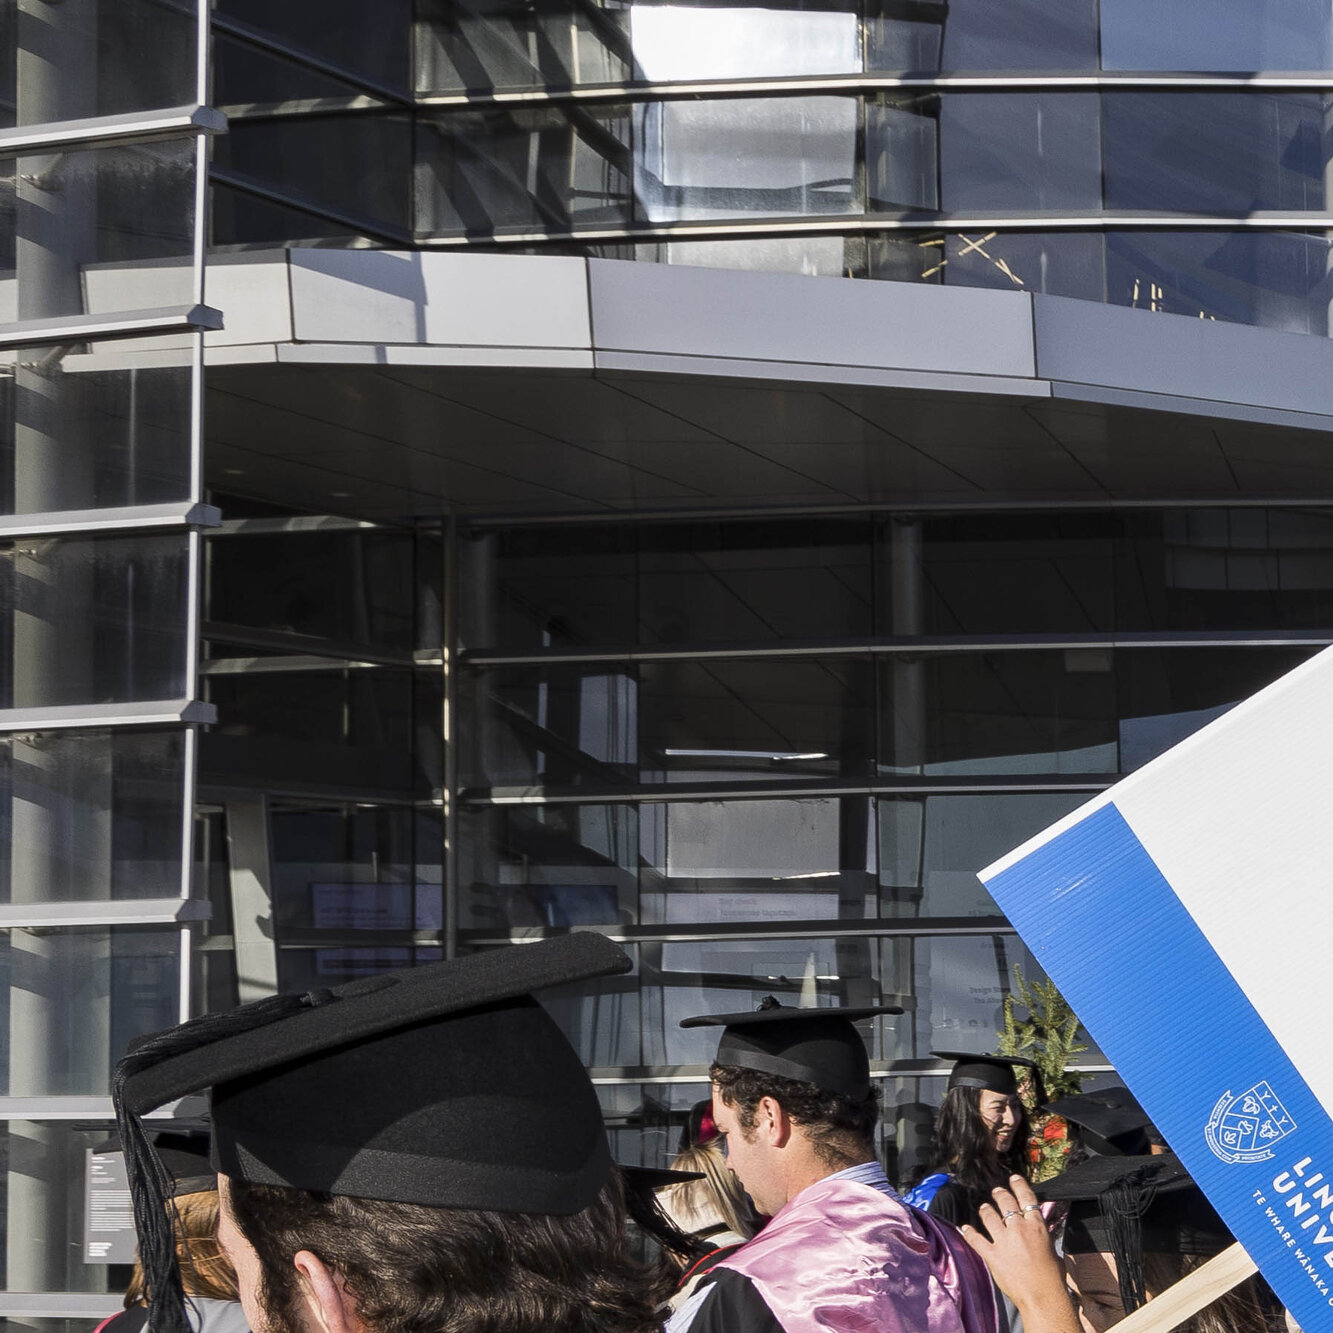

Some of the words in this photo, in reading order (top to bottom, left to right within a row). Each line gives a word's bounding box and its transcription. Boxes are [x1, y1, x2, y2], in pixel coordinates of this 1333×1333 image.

[1252, 1189, 1267, 1206] TE
[1265, 1206, 1296, 1248] WHARE
[1294, 1248, 1330, 1297] WĀNAKA
